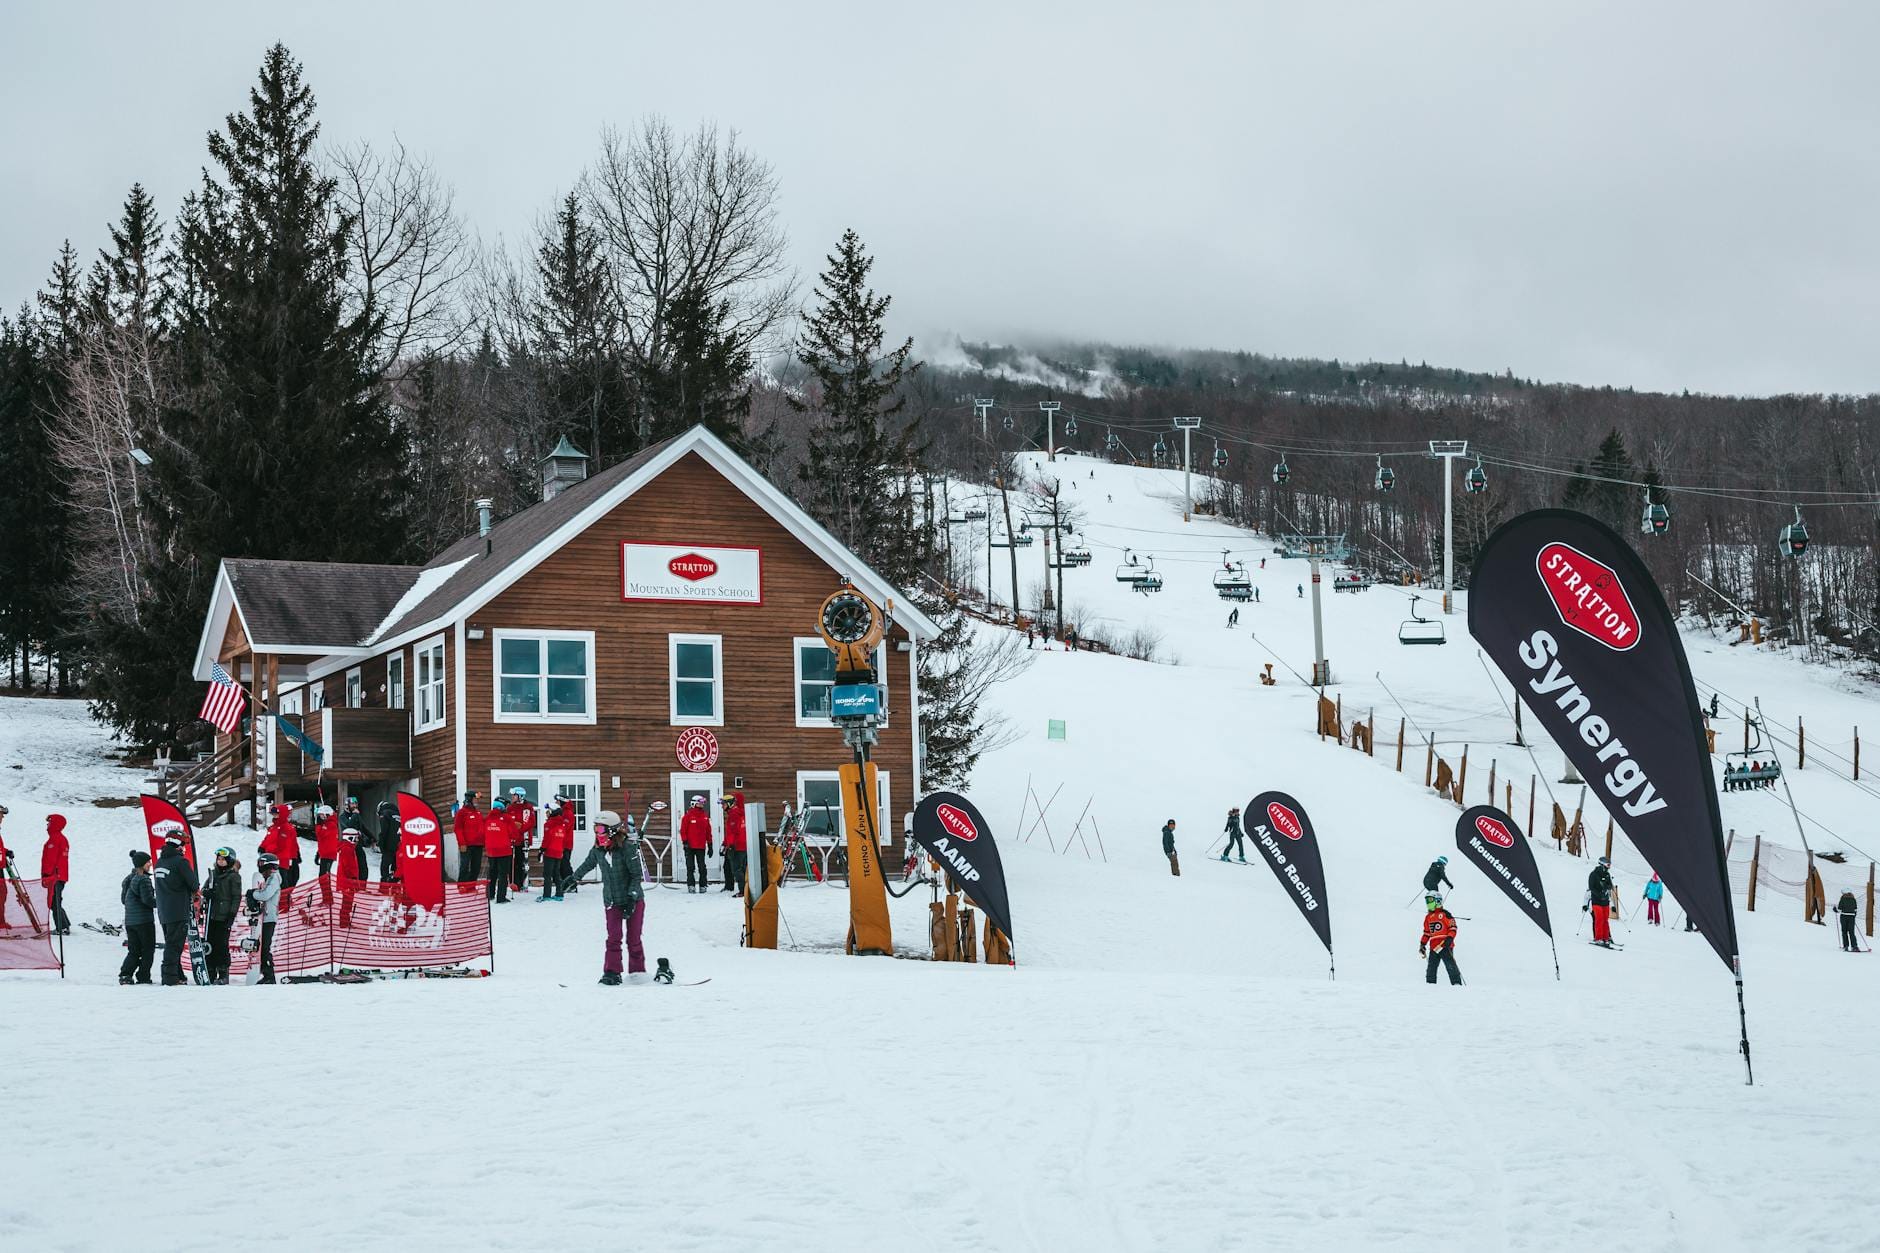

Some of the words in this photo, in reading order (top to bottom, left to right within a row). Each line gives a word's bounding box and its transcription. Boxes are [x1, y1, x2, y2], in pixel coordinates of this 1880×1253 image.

[671, 562, 714, 573] STRATTON
[1546, 553, 1632, 641] STRATTON
[1518, 630, 1668, 818] Synergy
[940, 807, 974, 838] STRATTON
[1270, 806, 1299, 837] STRATTON
[1478, 819, 1511, 845] STRATTON
[405, 844, 438, 859] U-Z
[932, 837, 981, 882] AAMP
[1254, 824, 1287, 865] Alpine
[1284, 863, 1319, 911] Racing
[1469, 836, 1512, 880] Mountain
[1510, 877, 1541, 909] Riders
